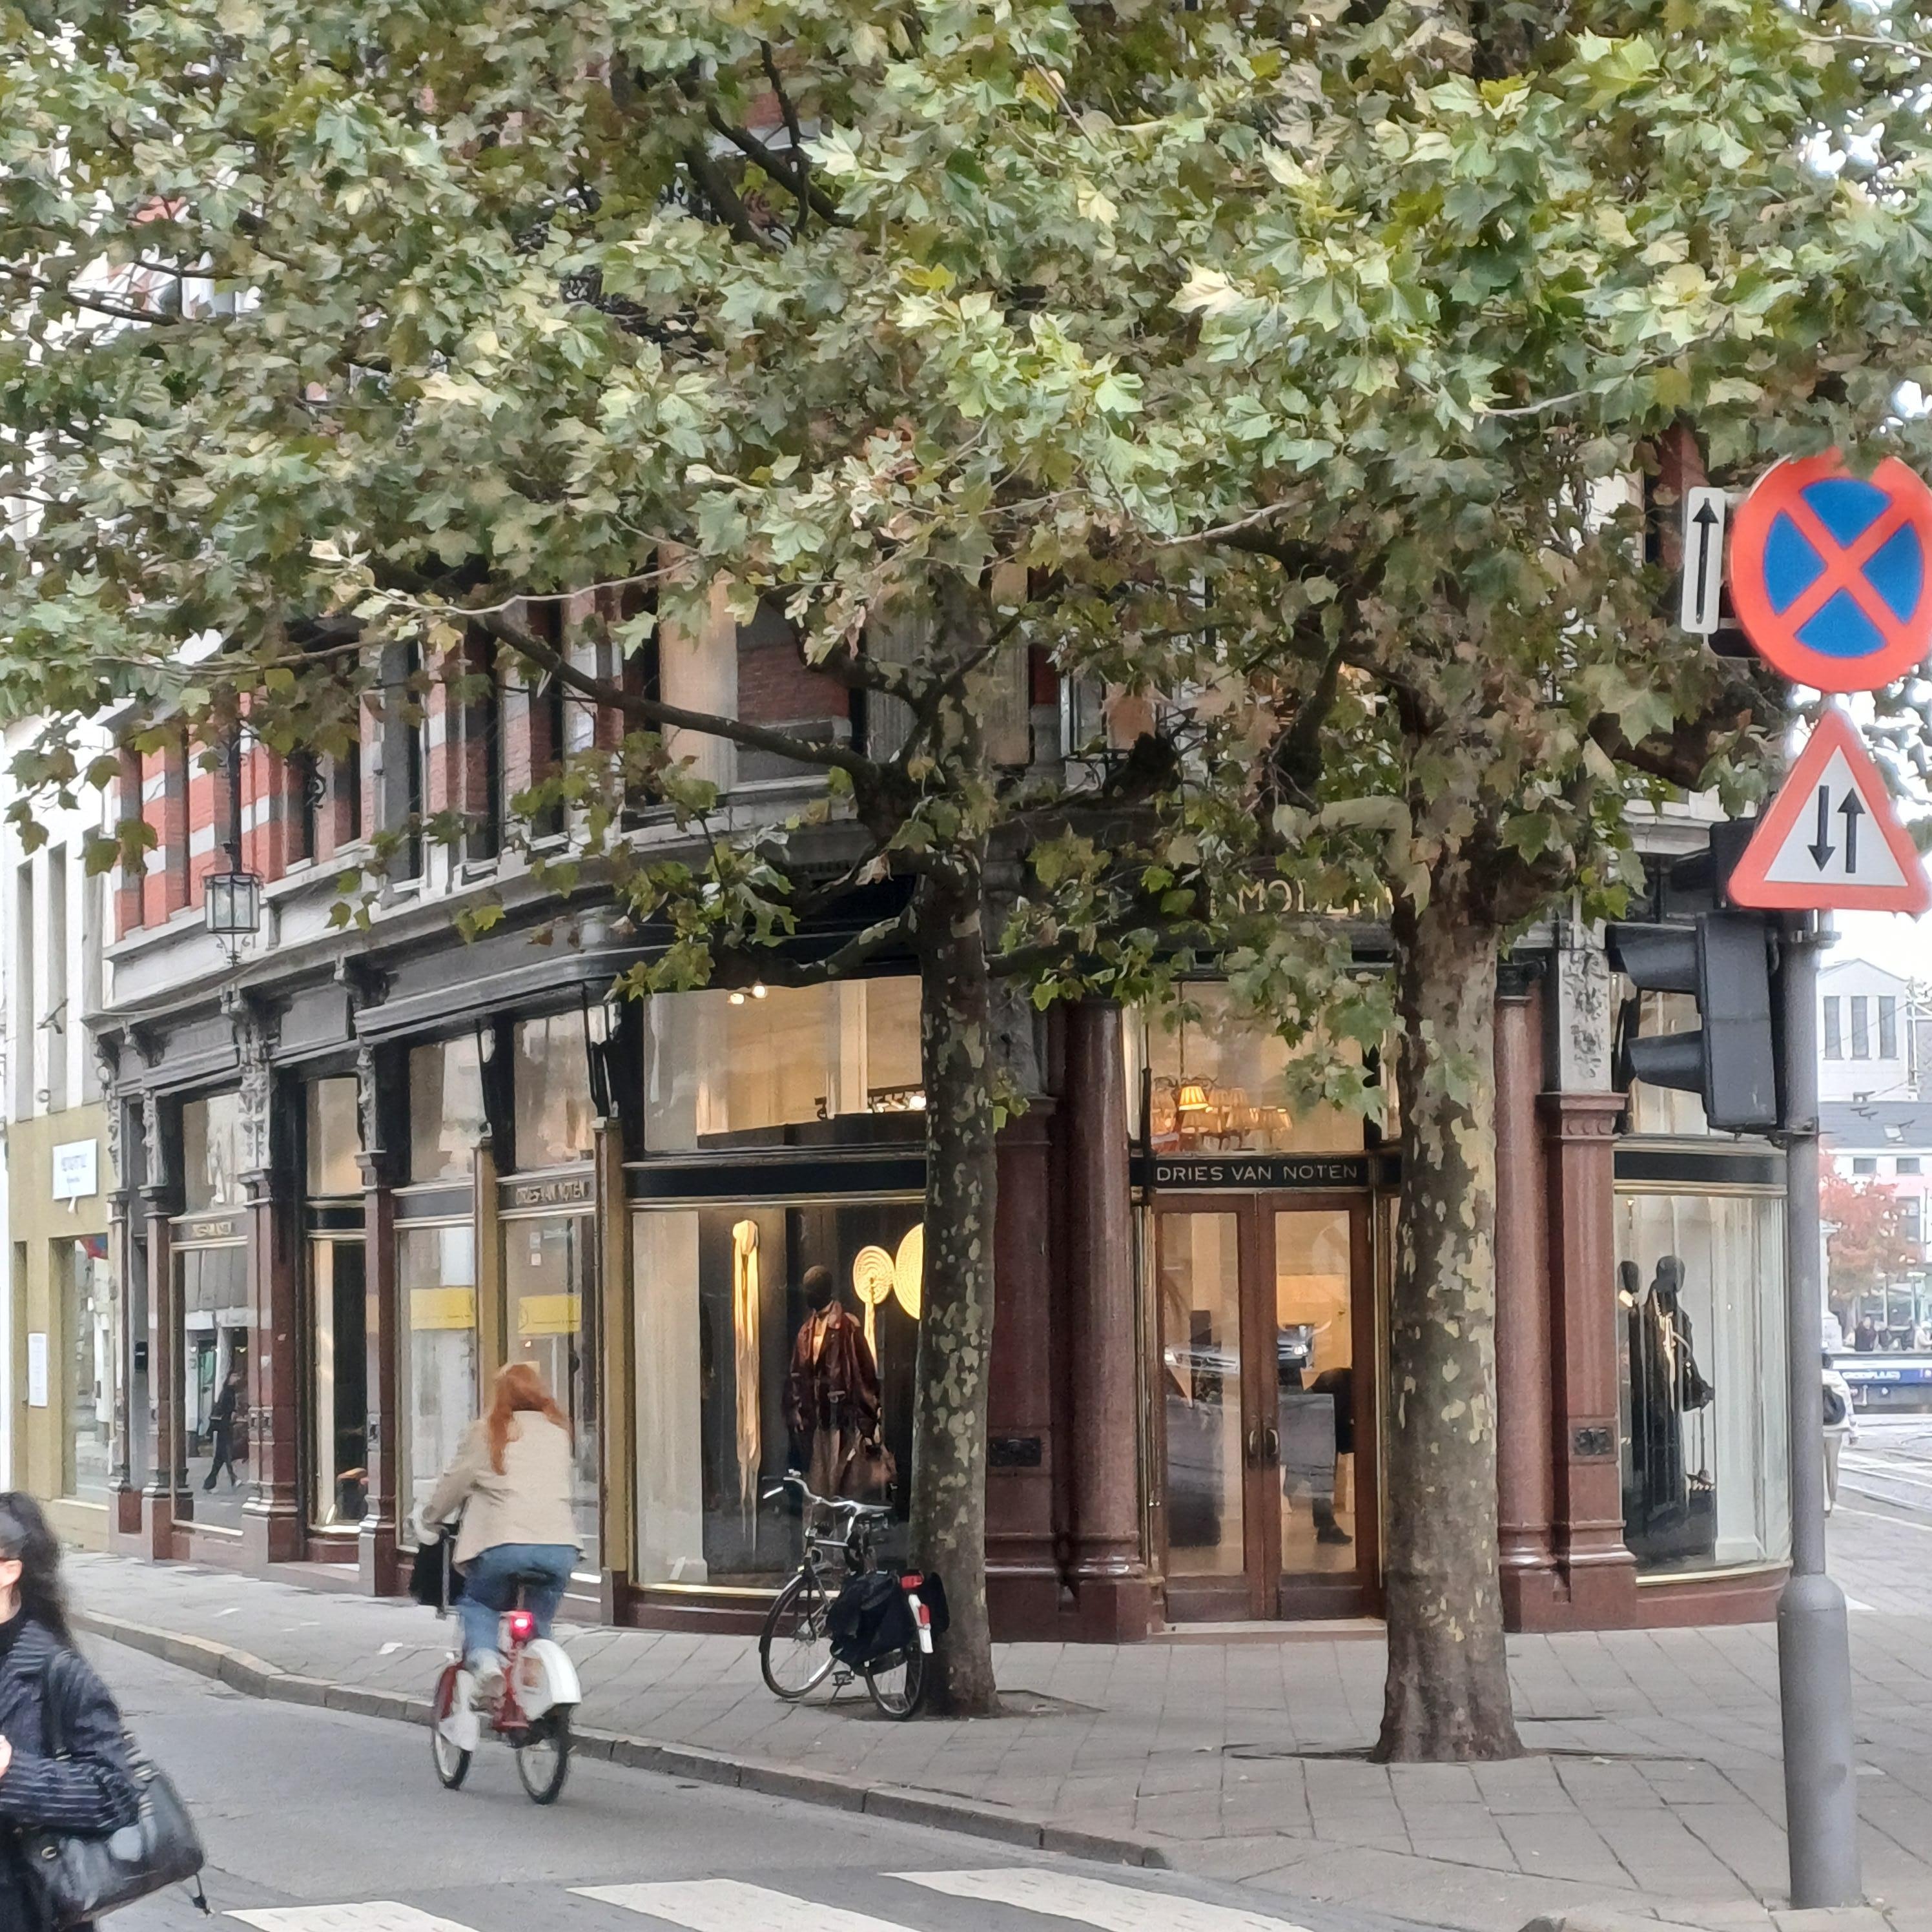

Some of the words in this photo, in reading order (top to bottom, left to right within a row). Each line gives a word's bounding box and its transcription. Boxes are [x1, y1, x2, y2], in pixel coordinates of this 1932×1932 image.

[1156, 1166, 1224, 1182] DRIES
[1231, 1166, 1272, 1180] VAN
[1283, 1164, 1357, 1180] NOTEN
